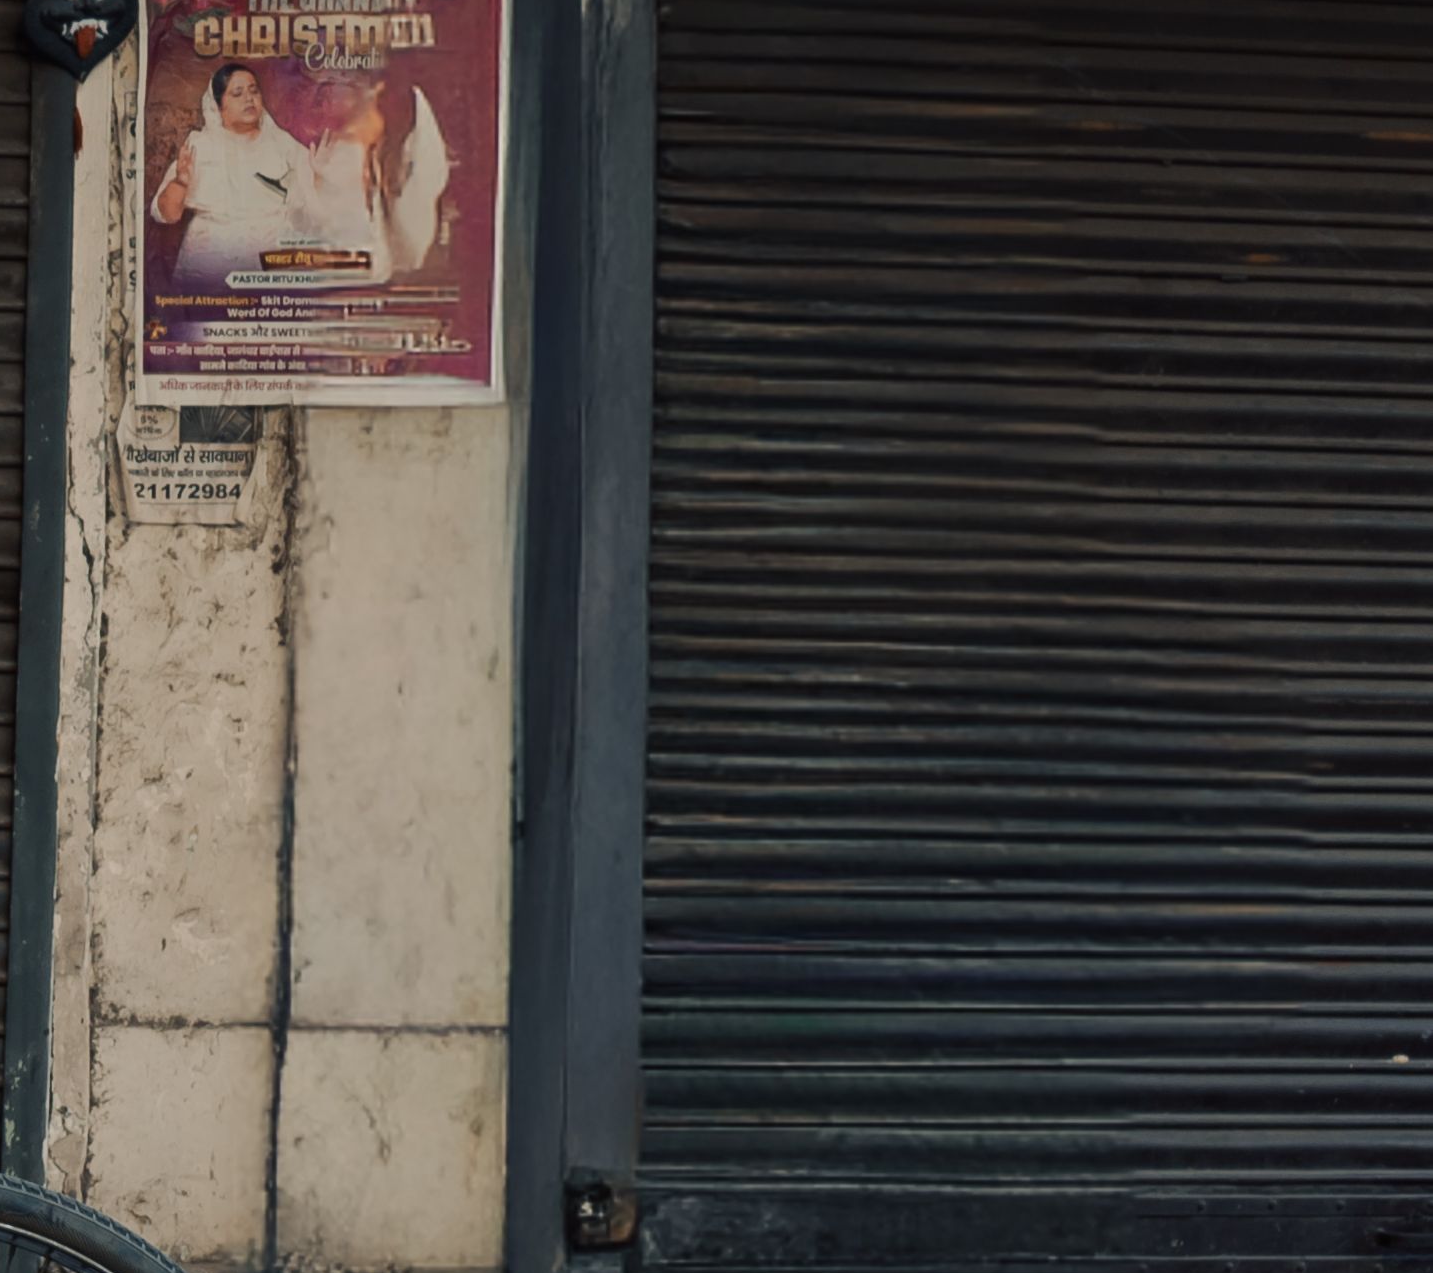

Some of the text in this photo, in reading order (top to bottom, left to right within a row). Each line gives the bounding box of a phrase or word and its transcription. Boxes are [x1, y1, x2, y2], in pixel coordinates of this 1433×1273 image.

[192, 14, 390, 57] CHRISTM
[232, 273, 270, 285] PASTOR
[272, 273, 294, 285] RITU
[155, 295, 193, 309] Special
[195, 294, 249, 307] Attraction
[260, 293, 280, 306] Skit
[227, 307, 258, 320] Word
[259, 307, 271, 320] Of
[272, 307, 296, 320] God
[203, 326, 248, 339] SNACKS
[183, 446, 195, 463] से
